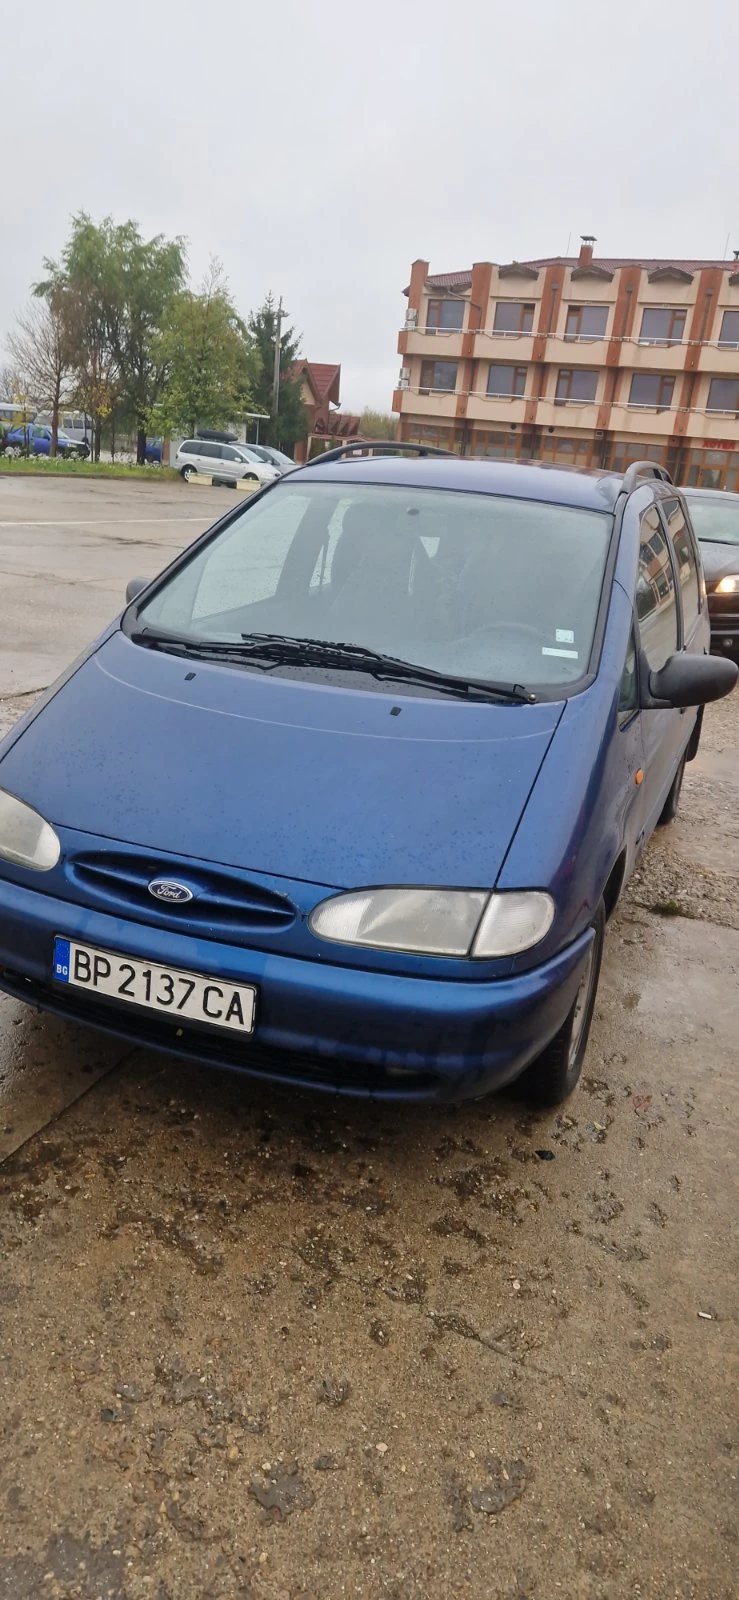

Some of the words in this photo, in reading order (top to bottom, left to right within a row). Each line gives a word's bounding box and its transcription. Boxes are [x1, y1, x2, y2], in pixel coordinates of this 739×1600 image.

[157, 884, 182, 899] Ford
[56, 964, 68, 976] BG
[73, 949, 111, 986] BP
[117, 963, 196, 1010] 2137
[202, 985, 245, 1025] CA
